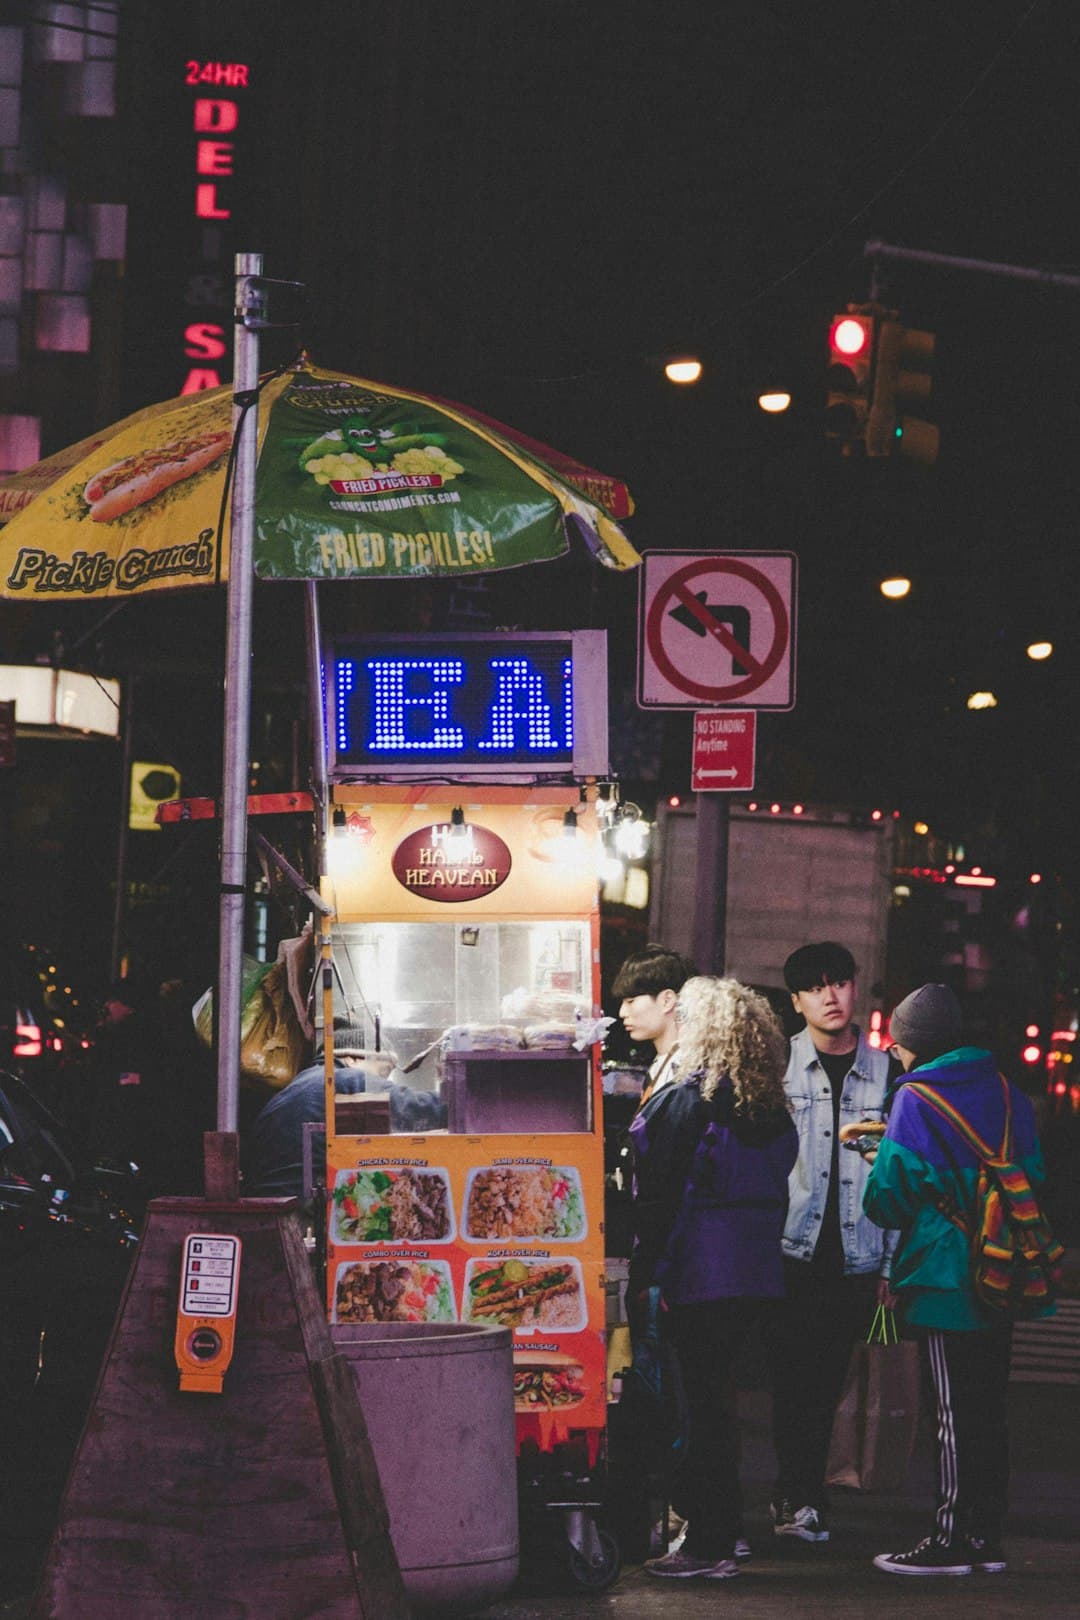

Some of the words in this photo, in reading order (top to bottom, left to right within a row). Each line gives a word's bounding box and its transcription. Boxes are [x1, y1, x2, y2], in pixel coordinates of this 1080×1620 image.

[185, 59, 249, 87] 24HR
[342, 479, 377, 493] FRIED
[380, 475, 432, 490] PICKLES!
[319, 533, 387, 569] FRIED
[391, 530, 497, 567] PICKLES!
[8, 548, 115, 593] Pickle
[115, 528, 214, 590] Crunch
[697, 719, 709, 734] NO
[709, 719, 746, 734] STANDING
[697, 737, 729, 754] Anytime
[405, 868, 498, 886] HEAVEAN
[357, 1158, 389, 1167] CHICKEN
[390, 1158, 410, 1166] OVER
[411, 1159, 428, 1167] RICE
[363, 1250, 389, 1259] COMBO
[390, 1250, 410, 1258] OVER
[411, 1250, 429, 1259] RICE
[512, 1248, 530, 1257] OVER
[532, 1249, 550, 1258] RICE
[525, 1343, 559, 1352] SAUSAGE
